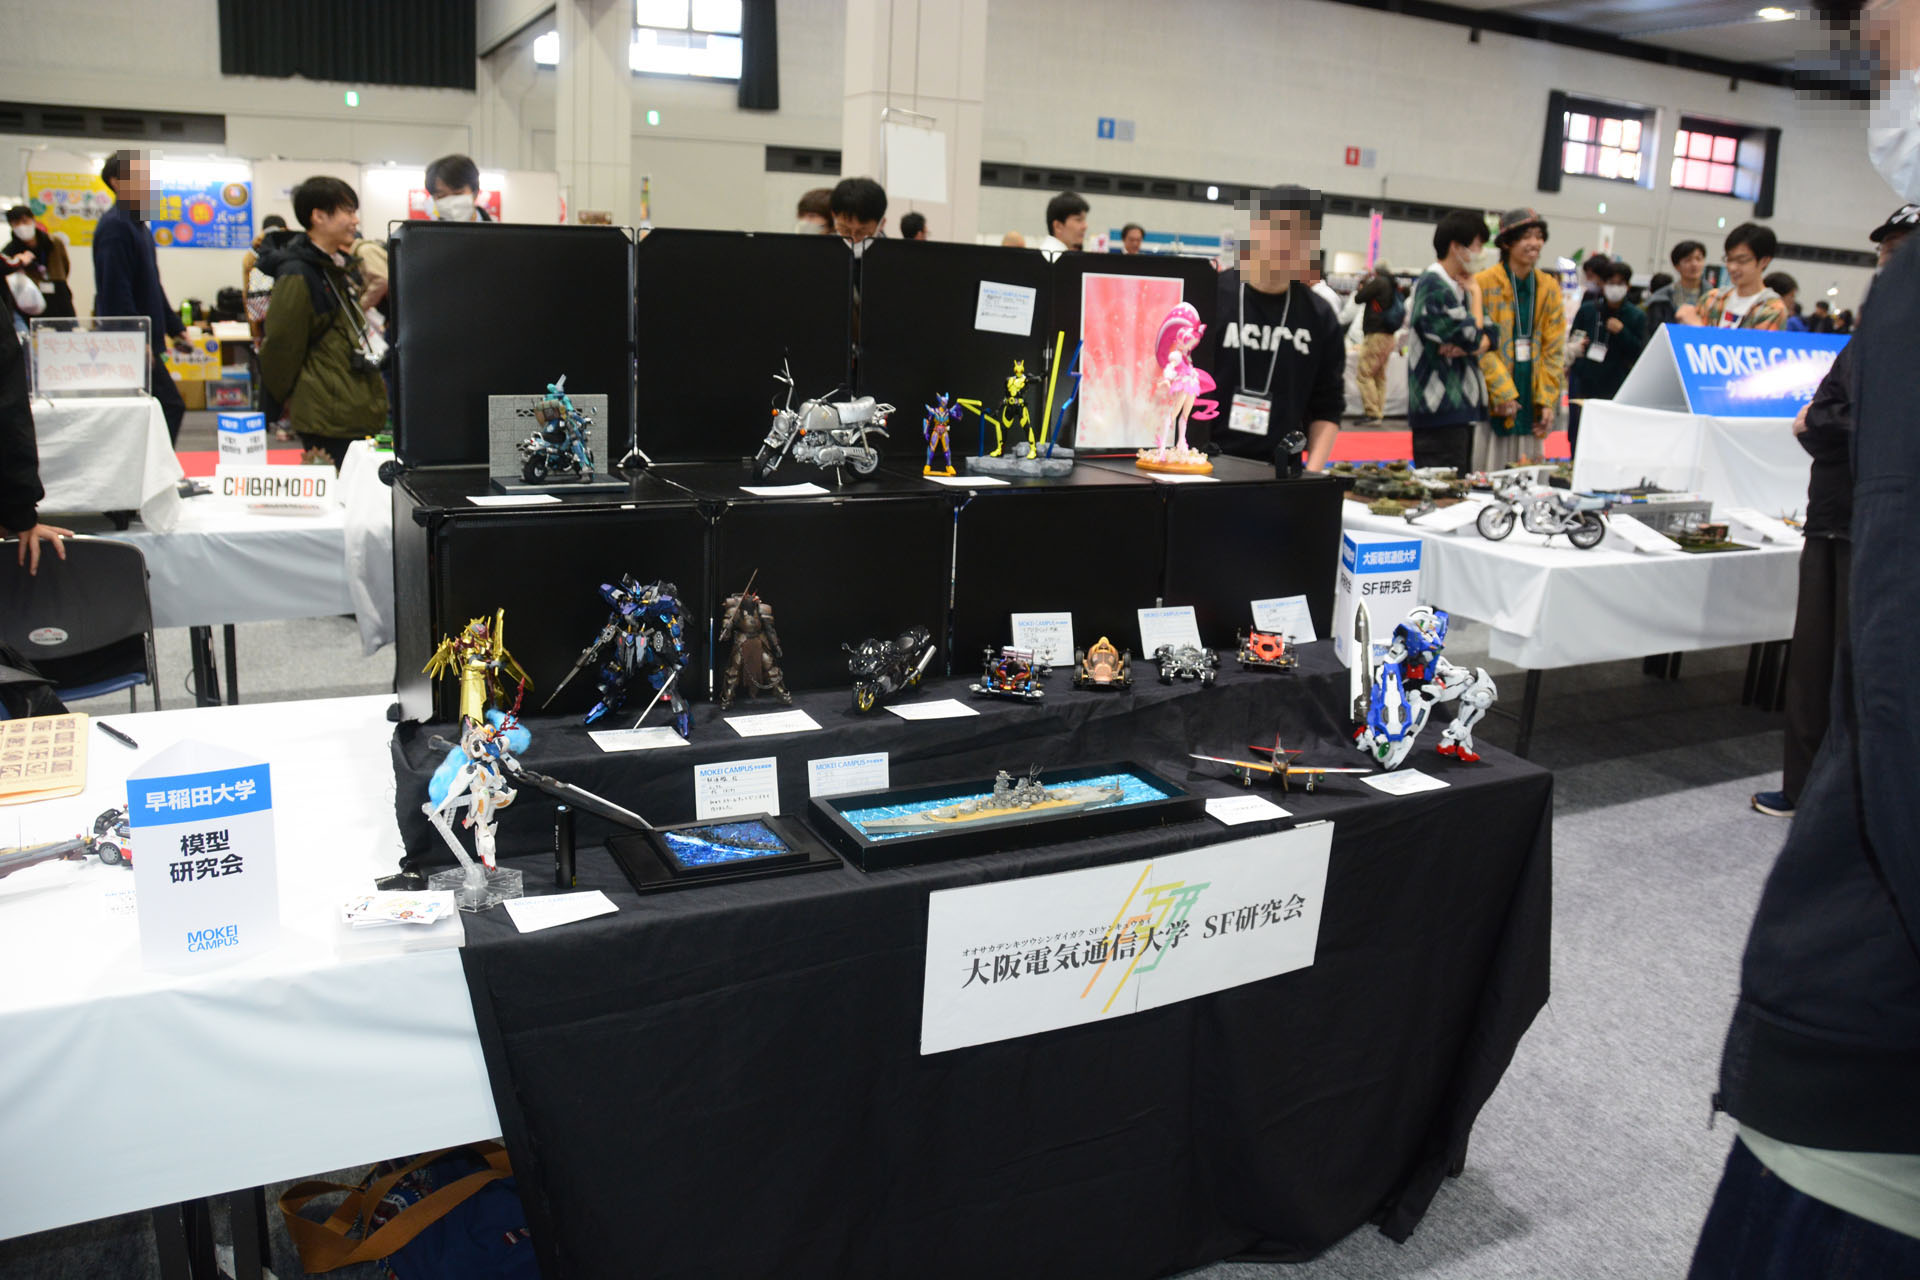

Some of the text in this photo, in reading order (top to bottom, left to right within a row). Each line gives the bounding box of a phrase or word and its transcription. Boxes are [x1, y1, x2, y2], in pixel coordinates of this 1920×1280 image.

[1222, 322, 1312, 355] ASICS
[1684, 343, 1767, 376] MOKEI
[1362, 549, 1417, 566] 大阪電気通信大学
[1361, 578, 1413, 596] SF研究会
[700, 767, 723, 777] MOKEI
[724, 764, 754, 775] CAMPUS
[838, 759, 866, 769] CAMPUS
[145, 779, 257, 812] 早稲田大学
[180, 829, 230, 857] 模型
[169, 853, 244, 883] 研究会
[187, 924, 238, 943] MOKEI
[188, 935, 239, 952] CAMPUS
[962, 893, 1307, 989] 大阪電気通信大学 SF研究会
